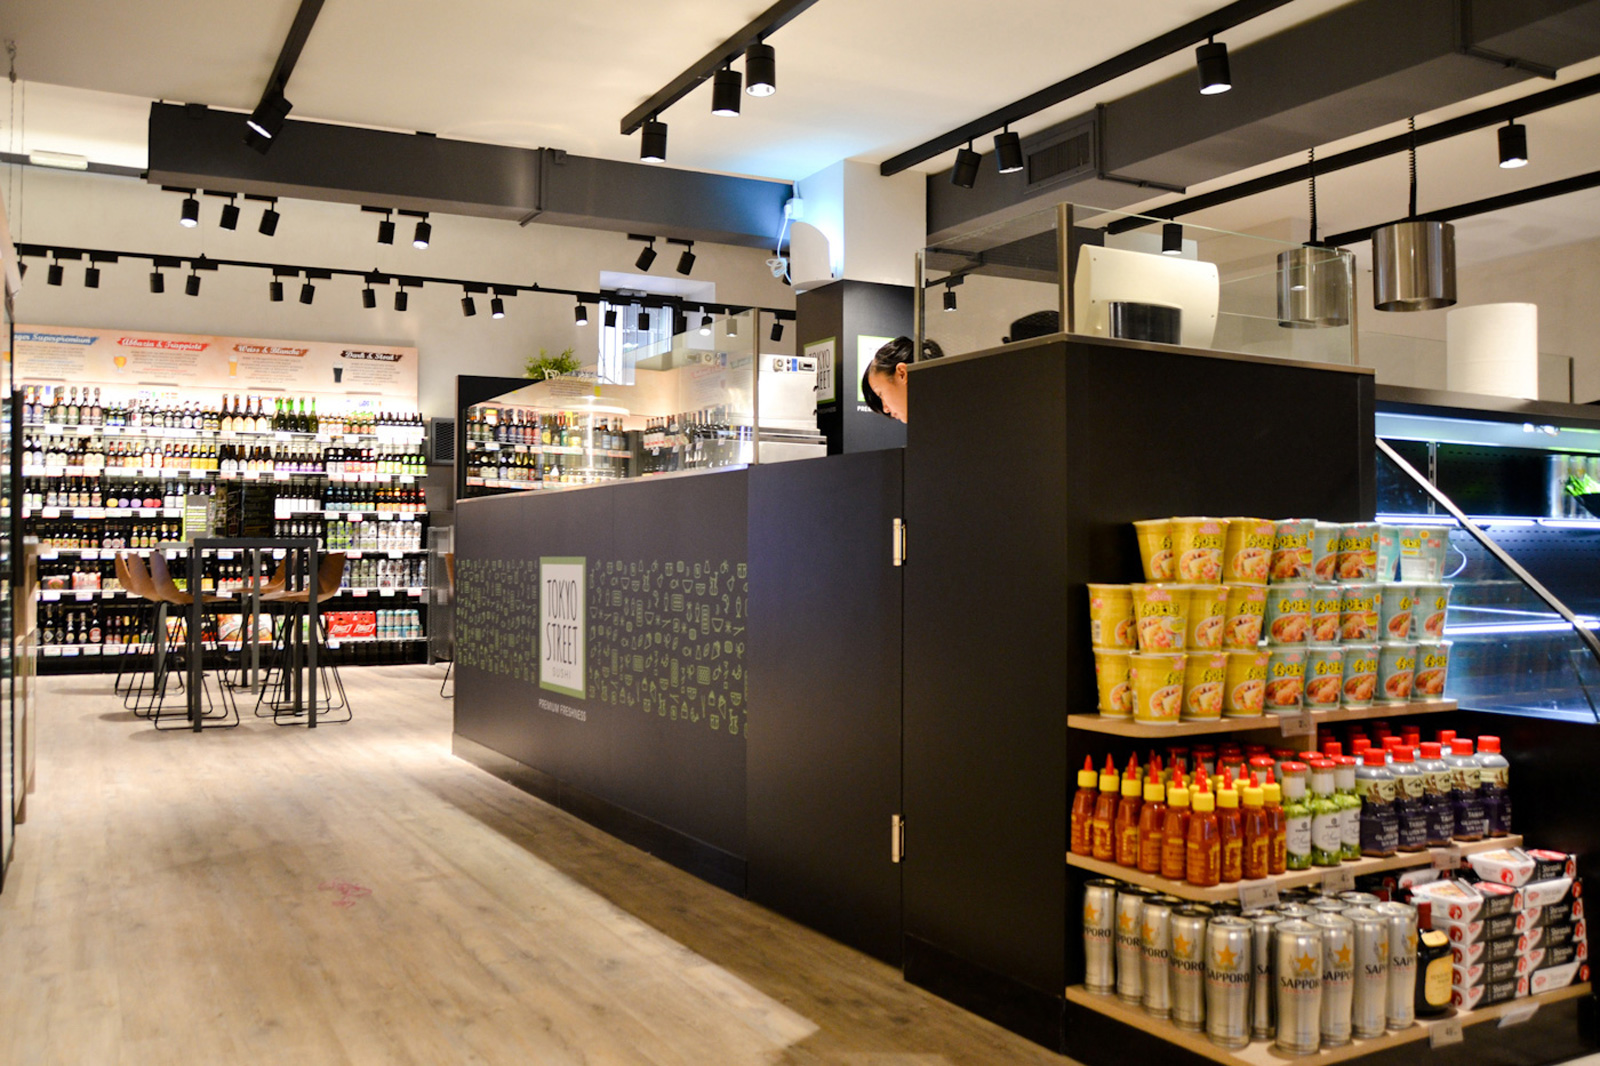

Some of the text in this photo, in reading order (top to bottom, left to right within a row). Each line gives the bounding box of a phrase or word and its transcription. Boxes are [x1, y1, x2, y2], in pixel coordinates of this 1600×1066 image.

[547, 579, 577, 621] TOKYO
[546, 621, 578, 666] STREET
[539, 698, 586, 722] PREMIUM FRESHNESS
[1206, 967, 1250, 983] SAPPORO
